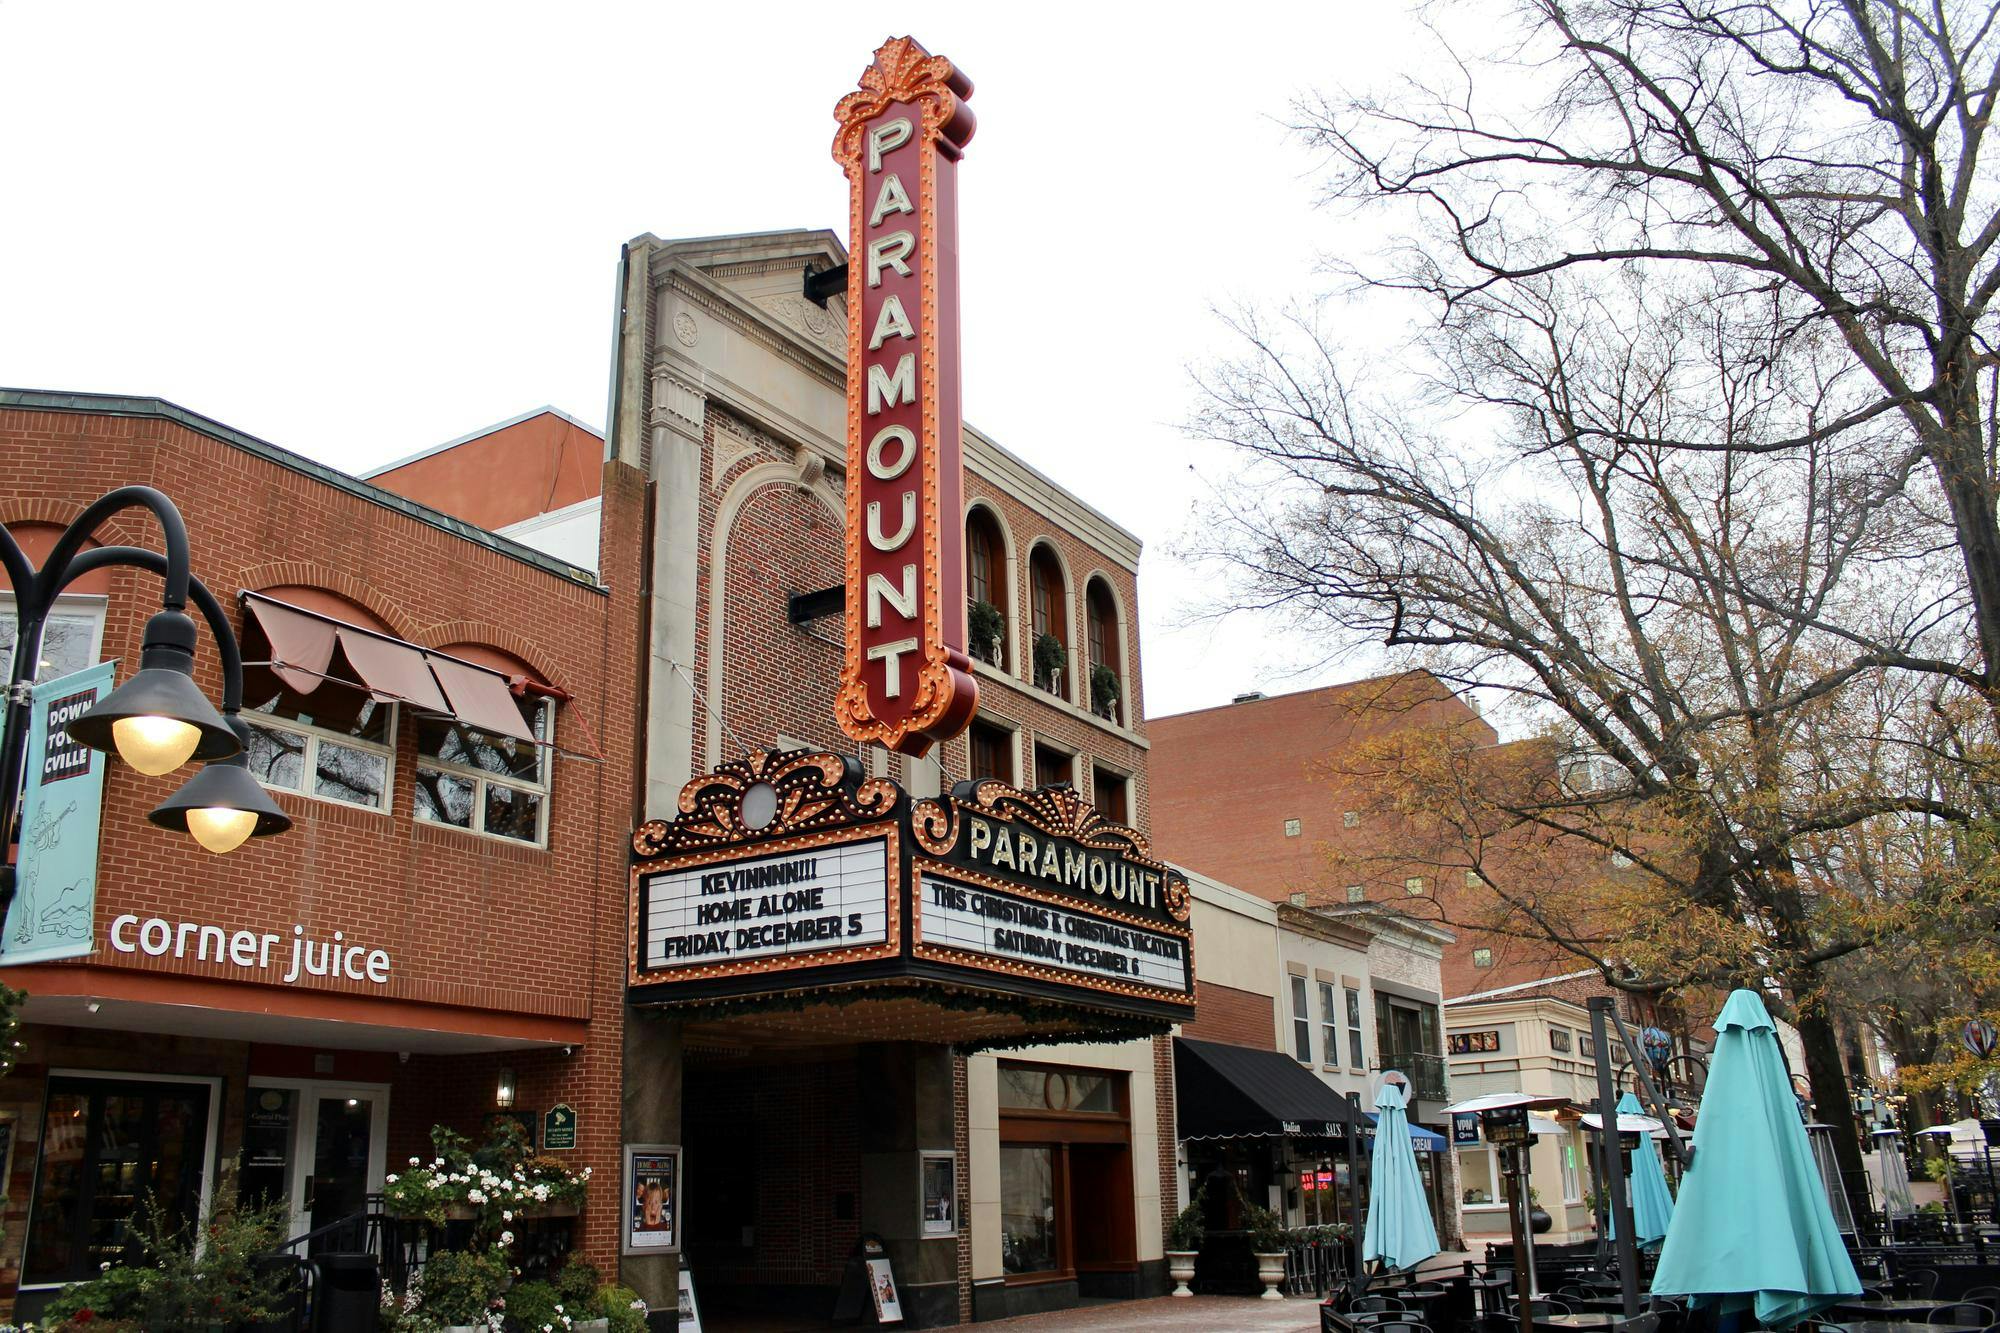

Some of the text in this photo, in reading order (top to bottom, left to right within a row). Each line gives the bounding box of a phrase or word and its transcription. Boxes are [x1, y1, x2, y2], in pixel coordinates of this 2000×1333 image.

[867, 116, 918, 698] PARAMOUNT
[50, 700, 92, 727] DOWN
[48, 731, 75, 750] TO
[44, 748, 88, 774] CVILLE
[970, 816, 1160, 909] PARAMOUNT
[697, 887, 824, 926] HOME ALONE
[932, 882, 1180, 961] THIS CHRISTMAS & CHRISTMAS VACATION
[109, 914, 391, 984] corner juice
[664, 913, 862, 958] FRIDAY, DECEMBER 5
[994, 927, 1140, 976] SATURDAY, DECEMBER 6
[1282, 1120, 1301, 1133] Italian
[1456, 1118, 1473, 1131] VPM
[1412, 1138, 1433, 1151] CREAM
